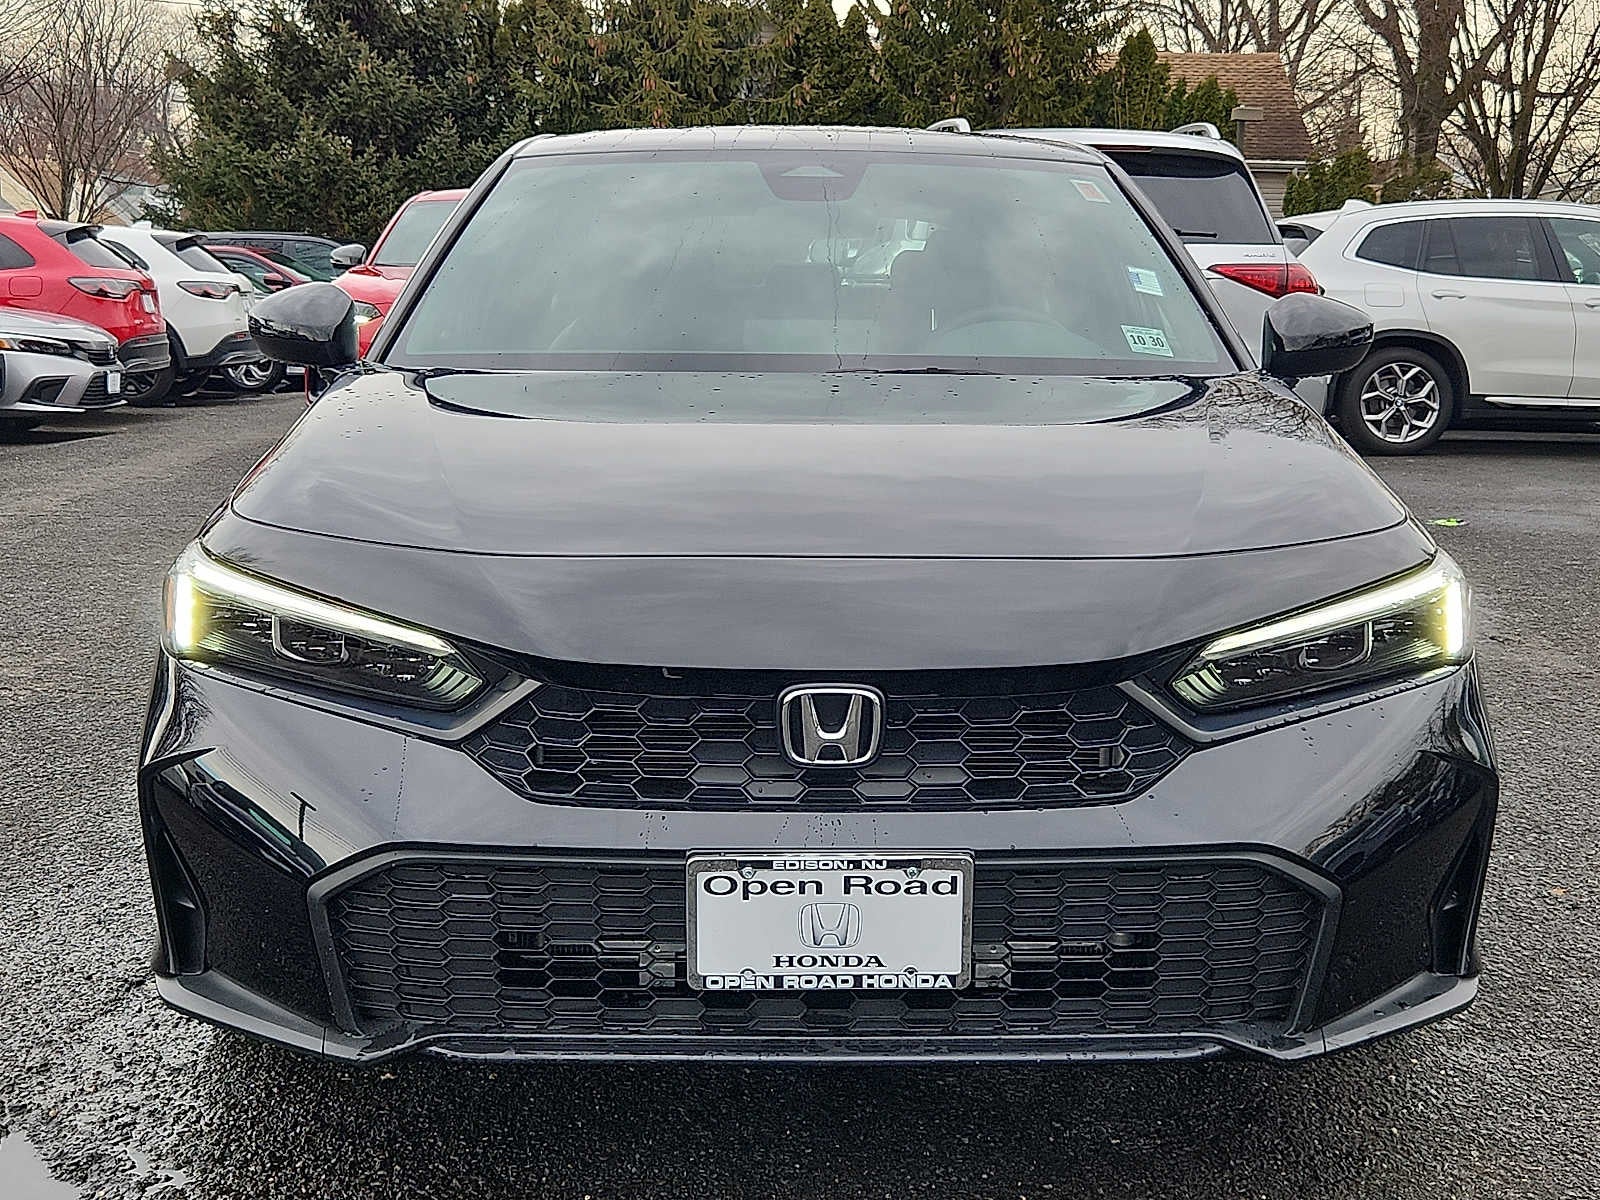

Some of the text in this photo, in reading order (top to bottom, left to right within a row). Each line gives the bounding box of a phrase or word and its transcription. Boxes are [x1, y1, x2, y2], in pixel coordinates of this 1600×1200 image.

[1130, 334, 1164, 348] 10 30
[772, 860, 888, 871] EDISON, NJ
[703, 875, 958, 901] Open Road
[772, 955, 887, 968] HONDA
[705, 975, 952, 989] OPEN ROAD HONDA
